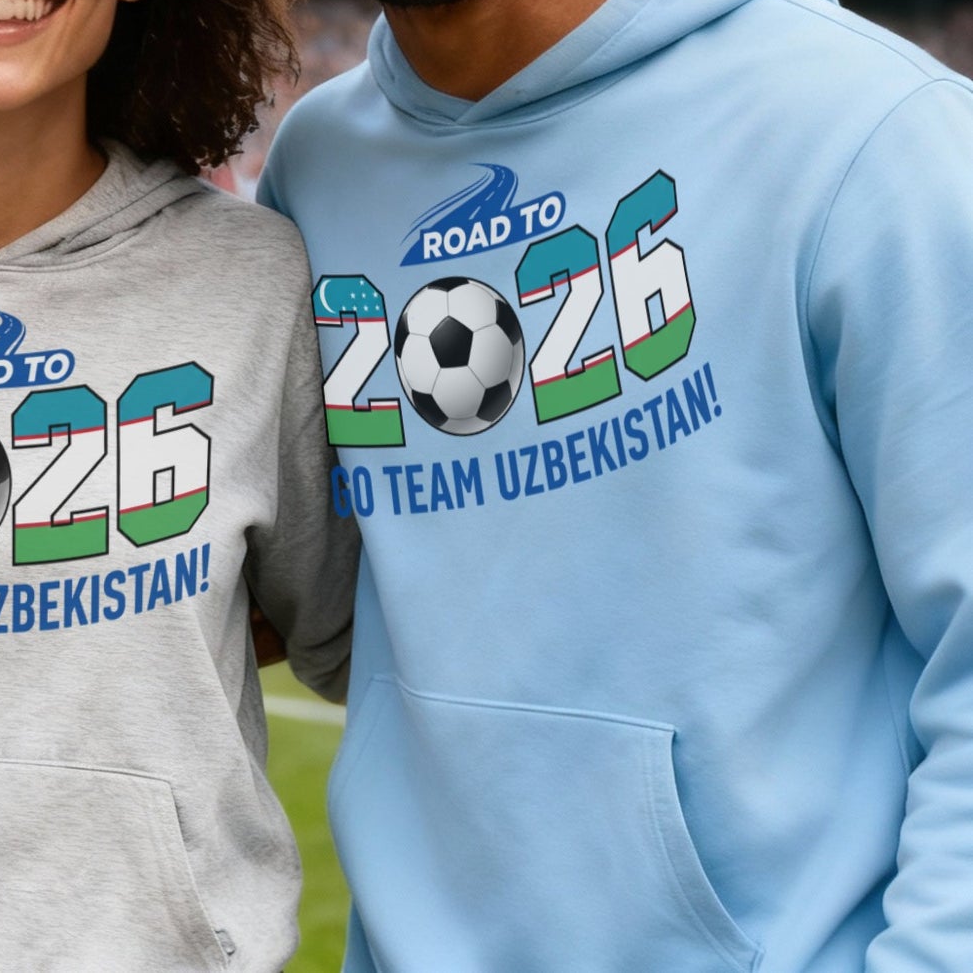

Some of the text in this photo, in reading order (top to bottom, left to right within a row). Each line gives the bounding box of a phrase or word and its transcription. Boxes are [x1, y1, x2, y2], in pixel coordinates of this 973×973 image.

[423, 195, 562, 259] ROAD TO
[24, 352, 70, 382] TO
[330, 362, 723, 519] GO TEAM UZBEKISTAN!
